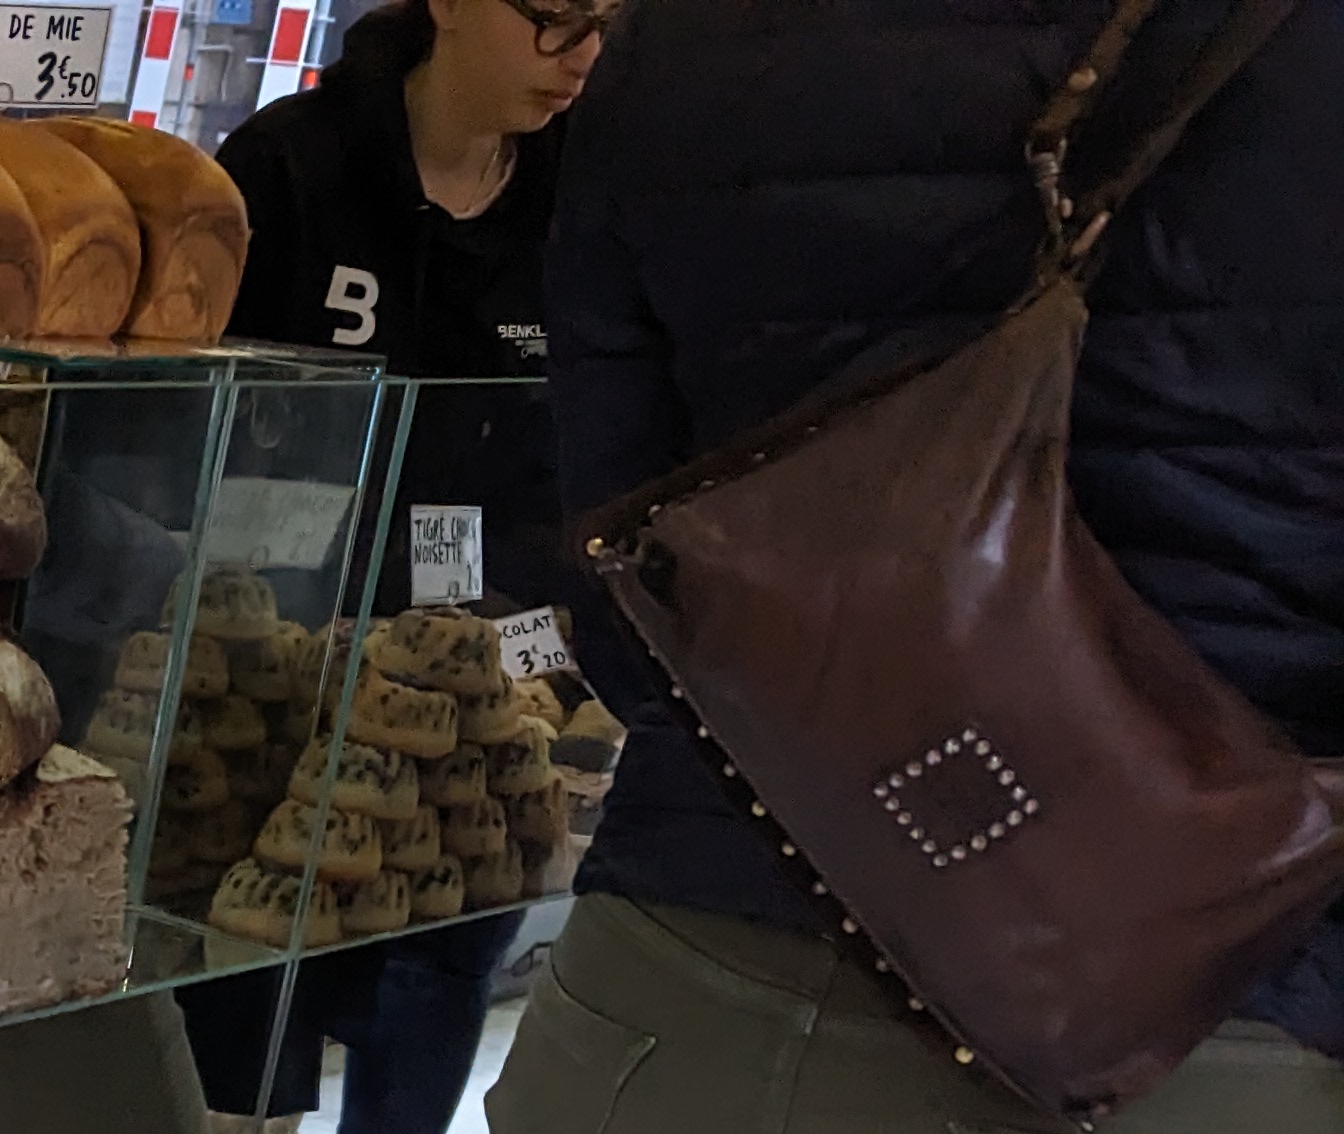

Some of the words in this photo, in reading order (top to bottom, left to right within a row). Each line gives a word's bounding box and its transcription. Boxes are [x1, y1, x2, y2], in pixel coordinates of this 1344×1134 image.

[9, 14, 36, 40] DE
[46, 15, 85, 41] MIE
[324, 265, 380, 346] B
[502, 615, 551, 639] COLAT
